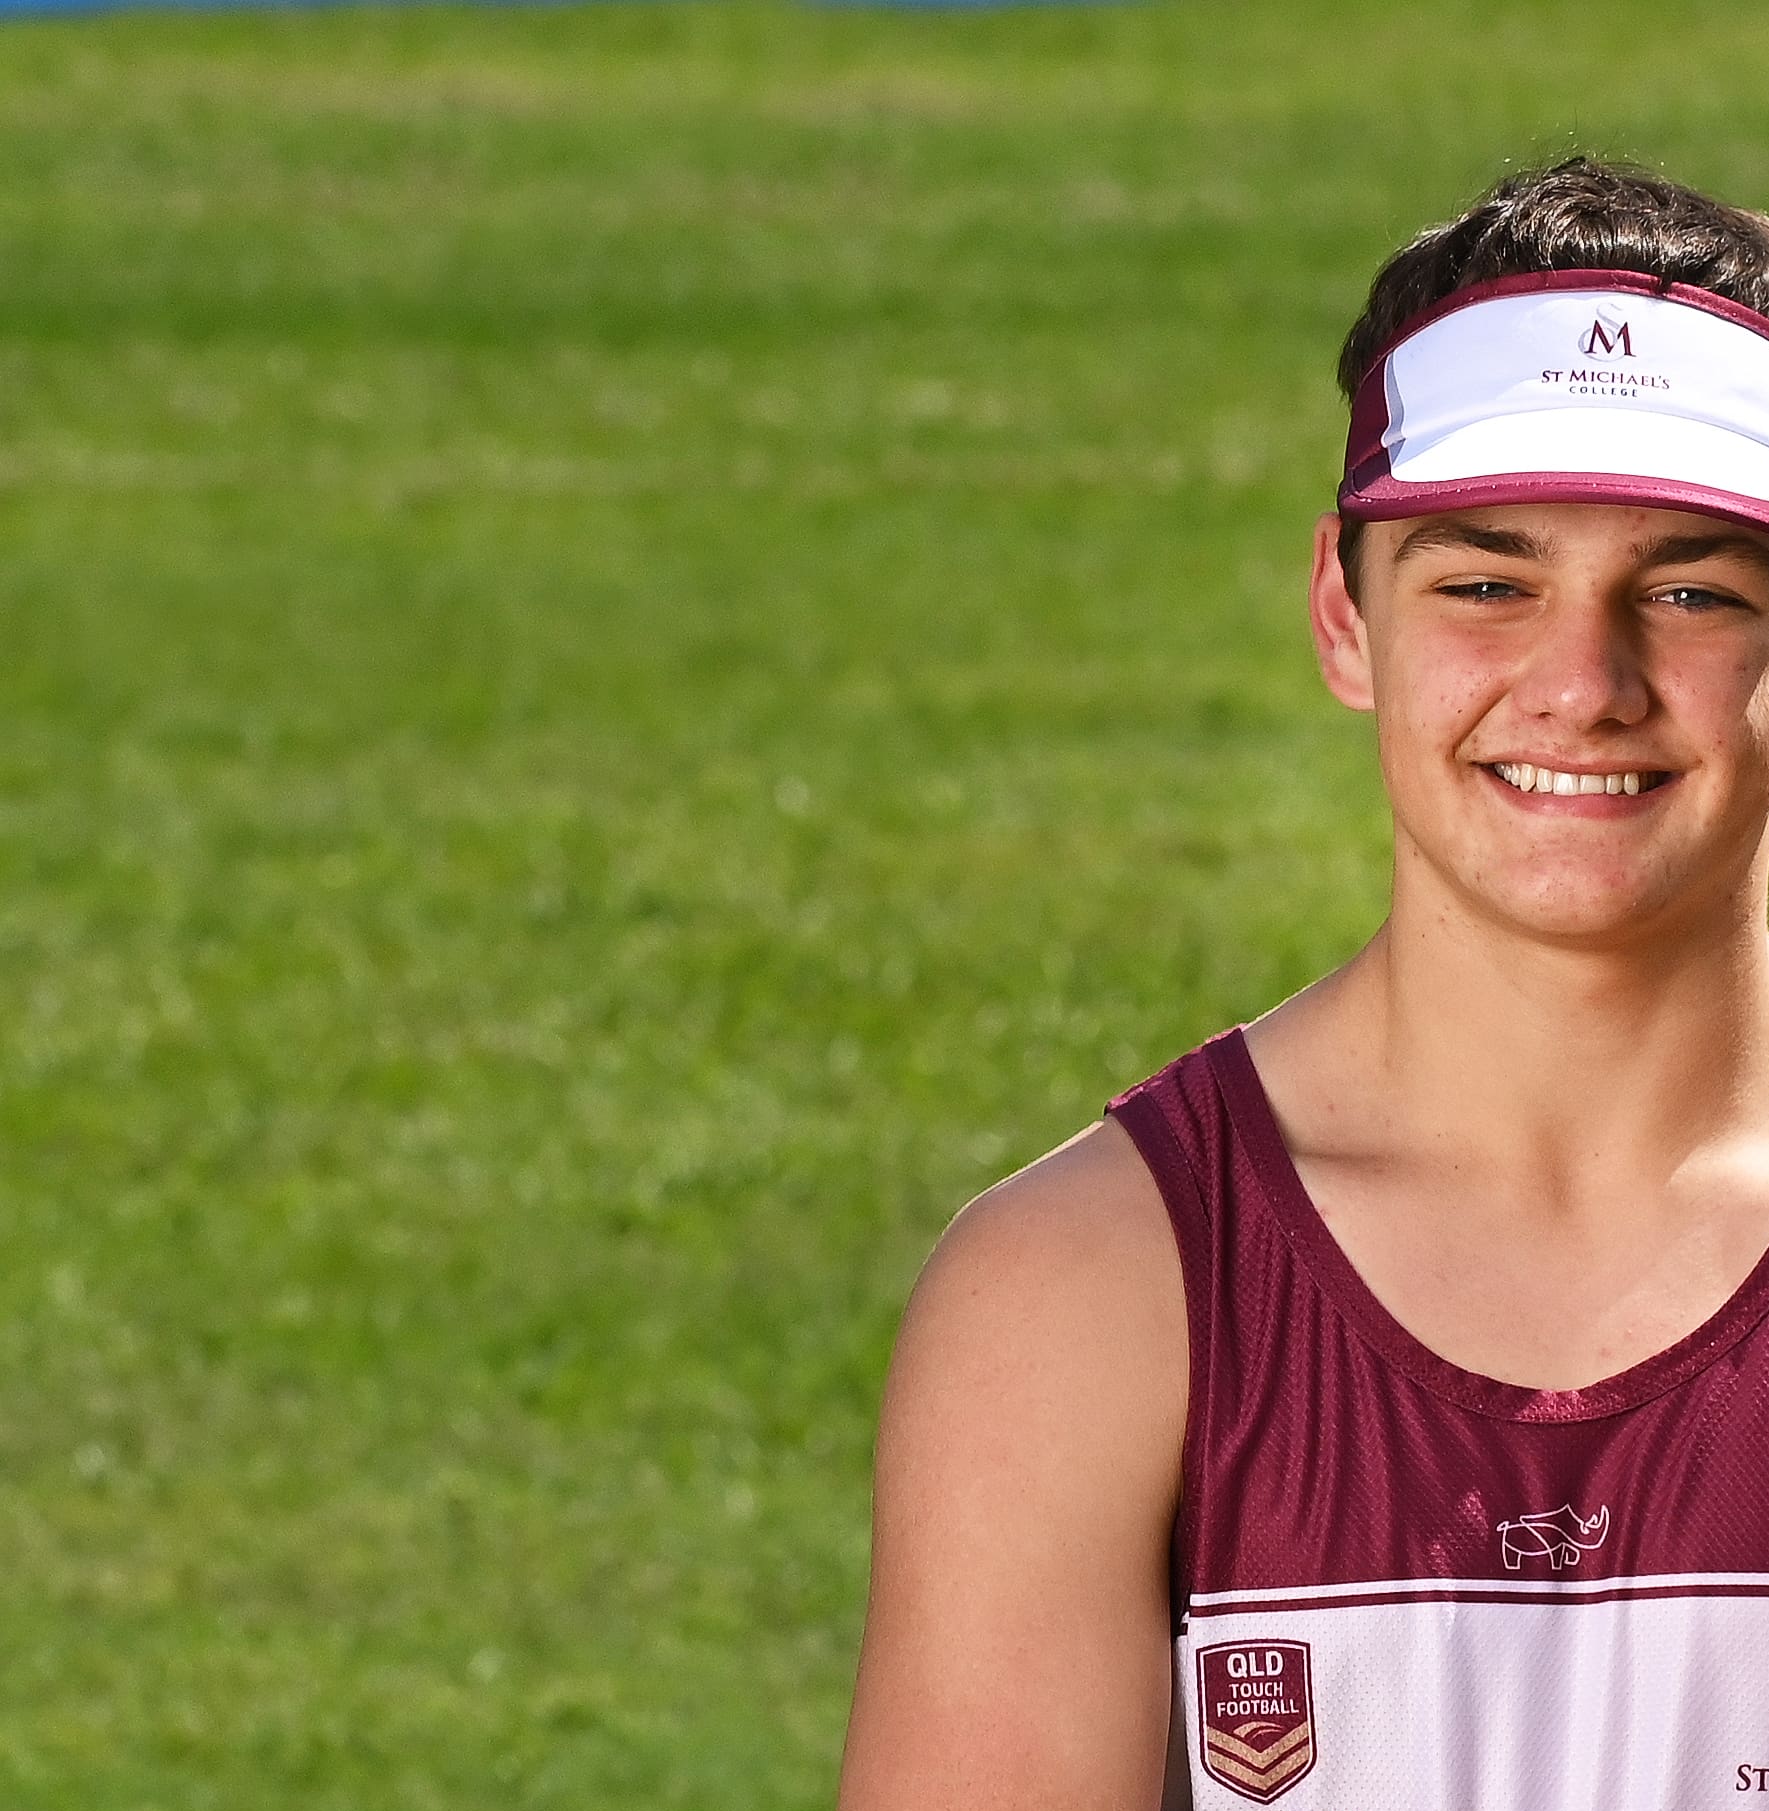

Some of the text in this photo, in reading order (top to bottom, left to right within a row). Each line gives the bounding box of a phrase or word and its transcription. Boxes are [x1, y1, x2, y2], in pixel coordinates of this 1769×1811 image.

[1541, 369, 1671, 390] ST MICHAEL'S
[1569, 386, 1638, 398] COLLEGE
[1226, 1650, 1285, 1679] QLD
[1229, 1682, 1284, 1699] TOUCH
[1216, 1699, 1300, 1718] FOOTBALL
